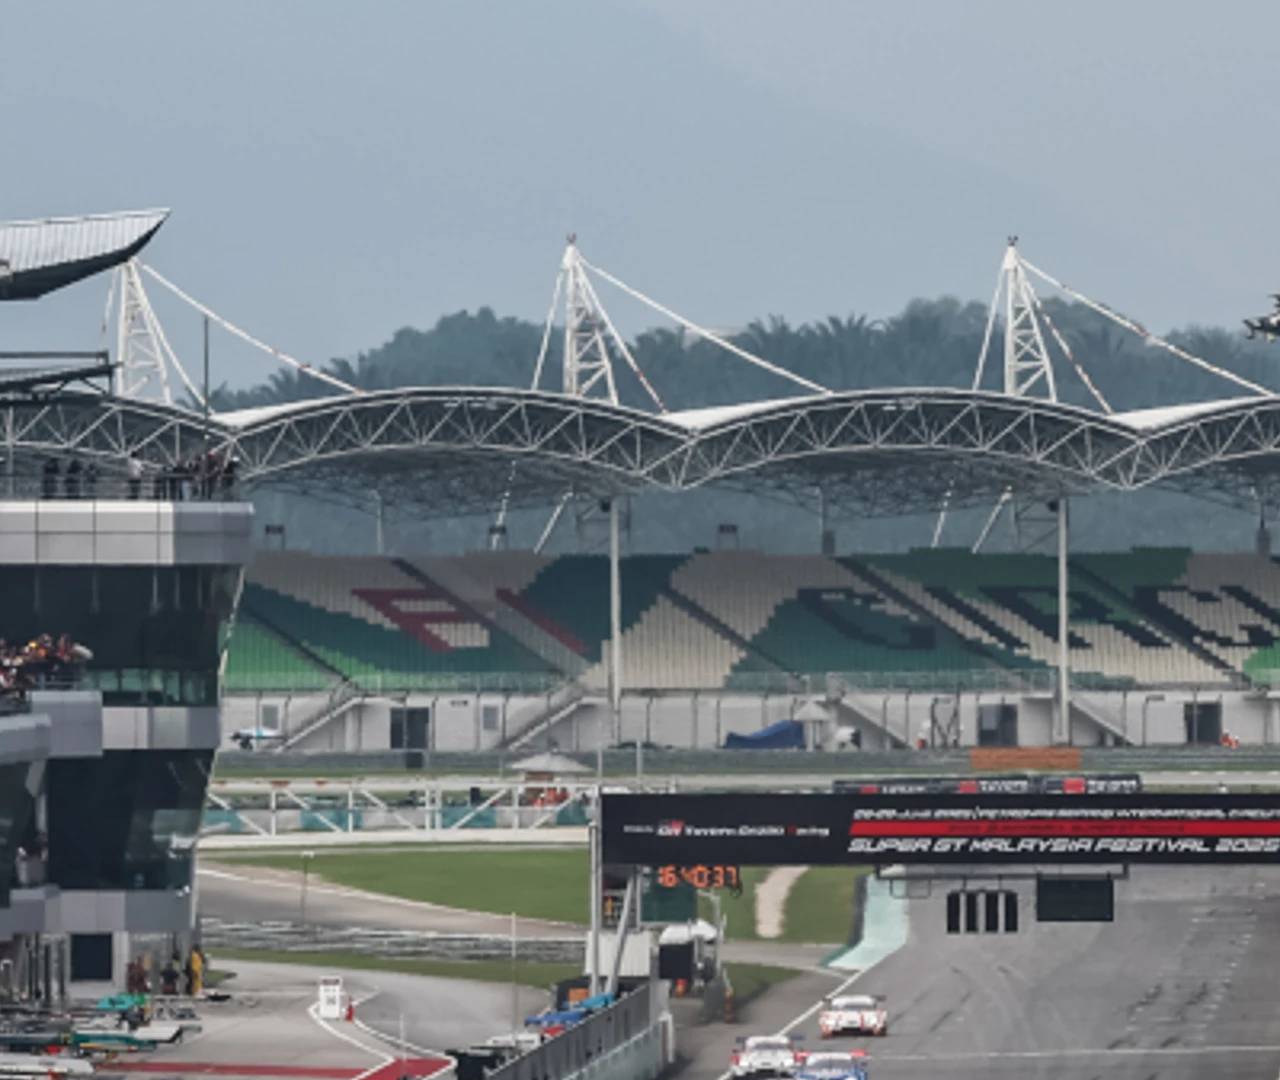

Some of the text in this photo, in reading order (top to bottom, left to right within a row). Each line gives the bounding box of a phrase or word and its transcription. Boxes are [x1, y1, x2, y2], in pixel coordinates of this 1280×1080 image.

[847, 837, 933, 853] SUPER
[932, 837, 969, 853] GT
[969, 837, 1095, 853] MALAYSIA
[1094, 837, 1211, 853] FESTIVAL
